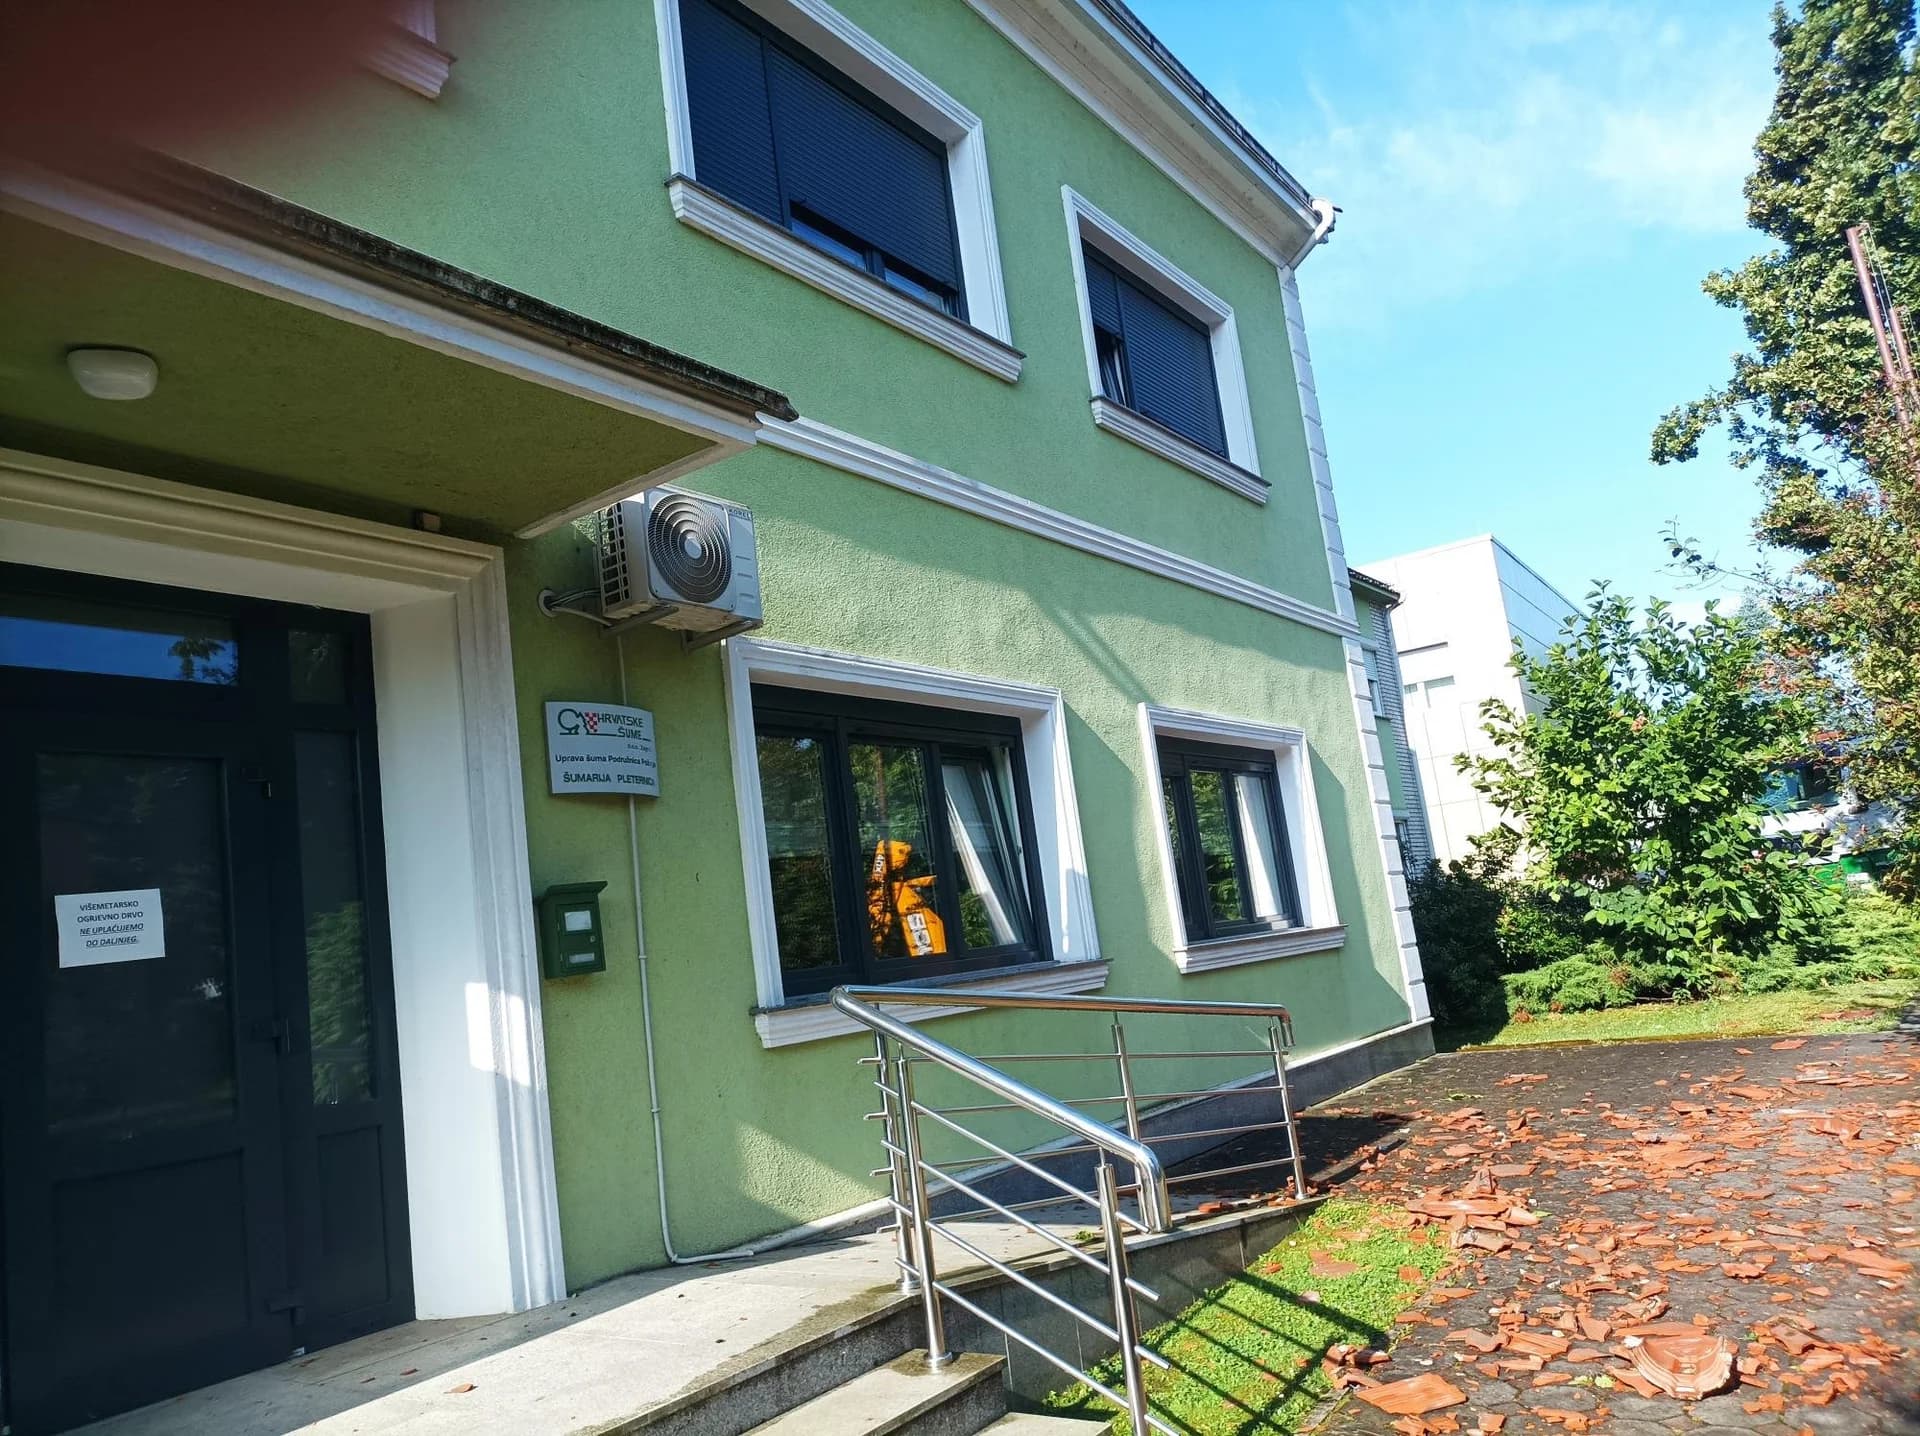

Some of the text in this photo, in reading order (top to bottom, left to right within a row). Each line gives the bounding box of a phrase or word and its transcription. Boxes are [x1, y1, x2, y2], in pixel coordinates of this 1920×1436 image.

[597, 713, 643, 727] HRVATSKE
[617, 726, 641, 739] ŠUME
[555, 754, 585, 764] Uprava
[586, 754, 607, 762] šuma
[563, 771, 612, 783] ŠUMARIJA
[79, 900, 139, 911] VIŠEMETARSKO
[77, 911, 144, 923] OGRJEVNO DRVO
[80, 927, 91, 935] NE
[86, 939, 98, 947] DO
